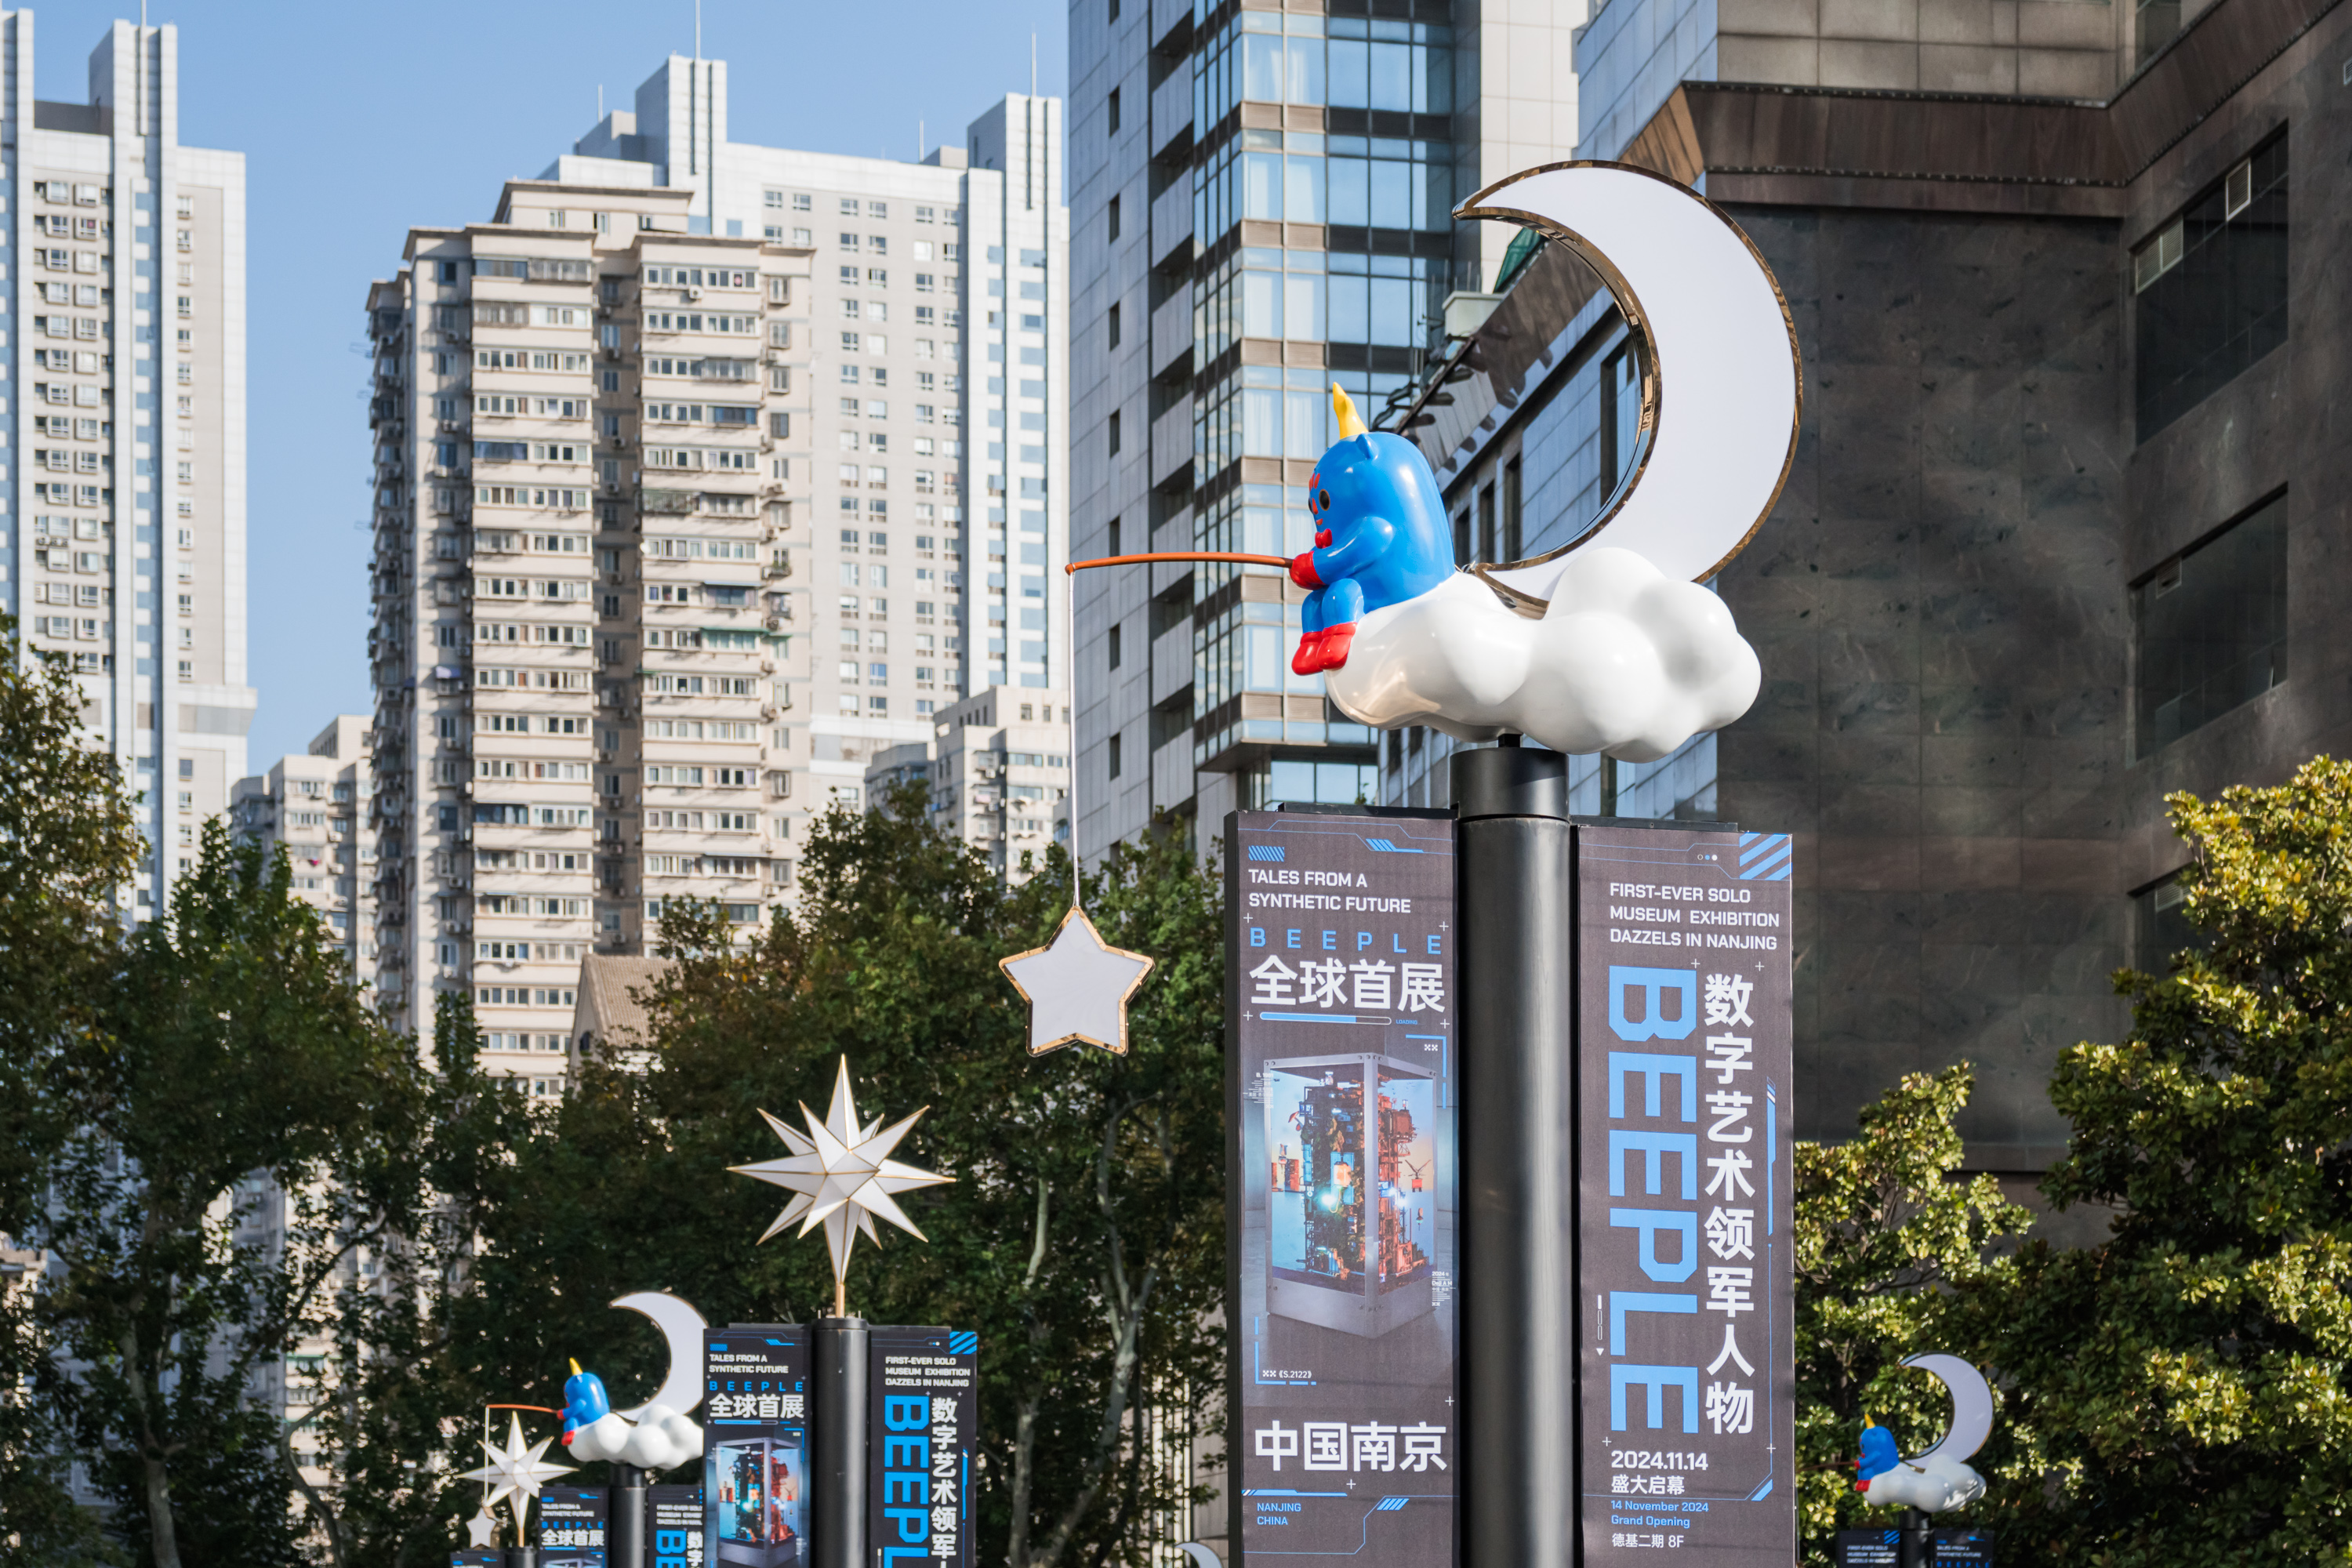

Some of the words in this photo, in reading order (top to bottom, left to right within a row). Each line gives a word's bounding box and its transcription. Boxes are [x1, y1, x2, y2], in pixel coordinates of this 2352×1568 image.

[1248, 869, 1299, 884] TALES
[1305, 871, 1352, 887] FROM
[1356, 873, 1368, 887] A
[1610, 882, 1704, 901] FIRST-EVER
[1708, 888, 1751, 903] SOLO
[1249, 893, 1341, 909] SYNTHETIC
[1345, 897, 1411, 913] FUTURE
[1610, 906, 1681, 923] MUSEUM
[1690, 910, 1780, 927] EXHIBITION
[1250, 927, 1441, 955] BEEPLE
[1610, 928, 1681, 946] DAZZELS
[1686, 933, 1702, 947] IN
[1706, 934, 1777, 950] NANJING
[1249, 954, 1446, 1013] 全球首展
[1609, 965, 1699, 1434] BEEPLE
[1704, 974, 1755, 1434] 数字艺术领军人物
[736, 1354, 760, 1363] FROM
[885, 1356, 933, 1365] FIRST-EVER
[934, 1357, 956, 1366] SOLO
[755, 1365, 789, 1374] FUTURE
[709, 1381, 804, 1392] BEEPLE
[885, 1377, 922, 1386] DAZZELS
[709, 1393, 804, 1418] 全球首展
[1255, 1420, 1447, 1472] 中国南京
[1611, 1450, 1708, 1471] 2024.11.14
[931, 1397, 957, 1568] 数字艺术领军
[1611, 1475, 1685, 1495] 盛大启幕
[1257, 1503, 1301, 1512] NANJING
[1610, 1500, 1622, 1510] 14
[1624, 1501, 1679, 1512] November
[1682, 1502, 1709, 1512] 2024
[1257, 1516, 1288, 1526] CHINA
[1611, 1515, 1643, 1525] Grand
[1646, 1515, 1690, 1529] Opening
[541, 1529, 604, 1546] 全球首展
[1611, 1533, 1664, 1548] 德基二期
[1668, 1534, 1684, 1548] 8F
